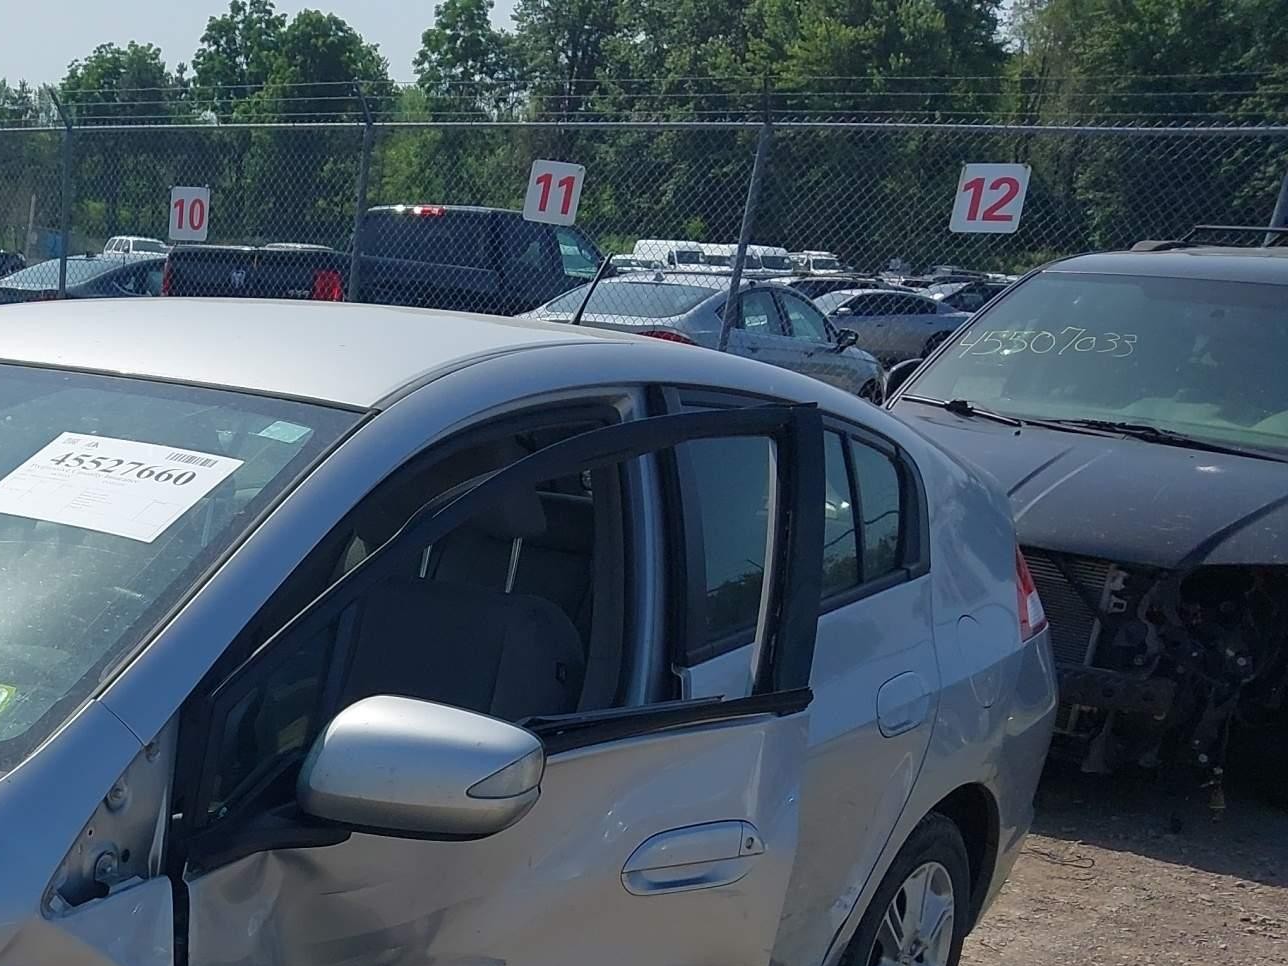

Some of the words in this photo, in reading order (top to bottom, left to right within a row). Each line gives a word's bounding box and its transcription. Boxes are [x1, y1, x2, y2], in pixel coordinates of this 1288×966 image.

[535, 173, 576, 216] 11
[962, 176, 1020, 222] 12
[173, 197, 205, 231] 10
[958, 326, 1138, 358] 45507033
[49, 451, 197, 486] 45527660
